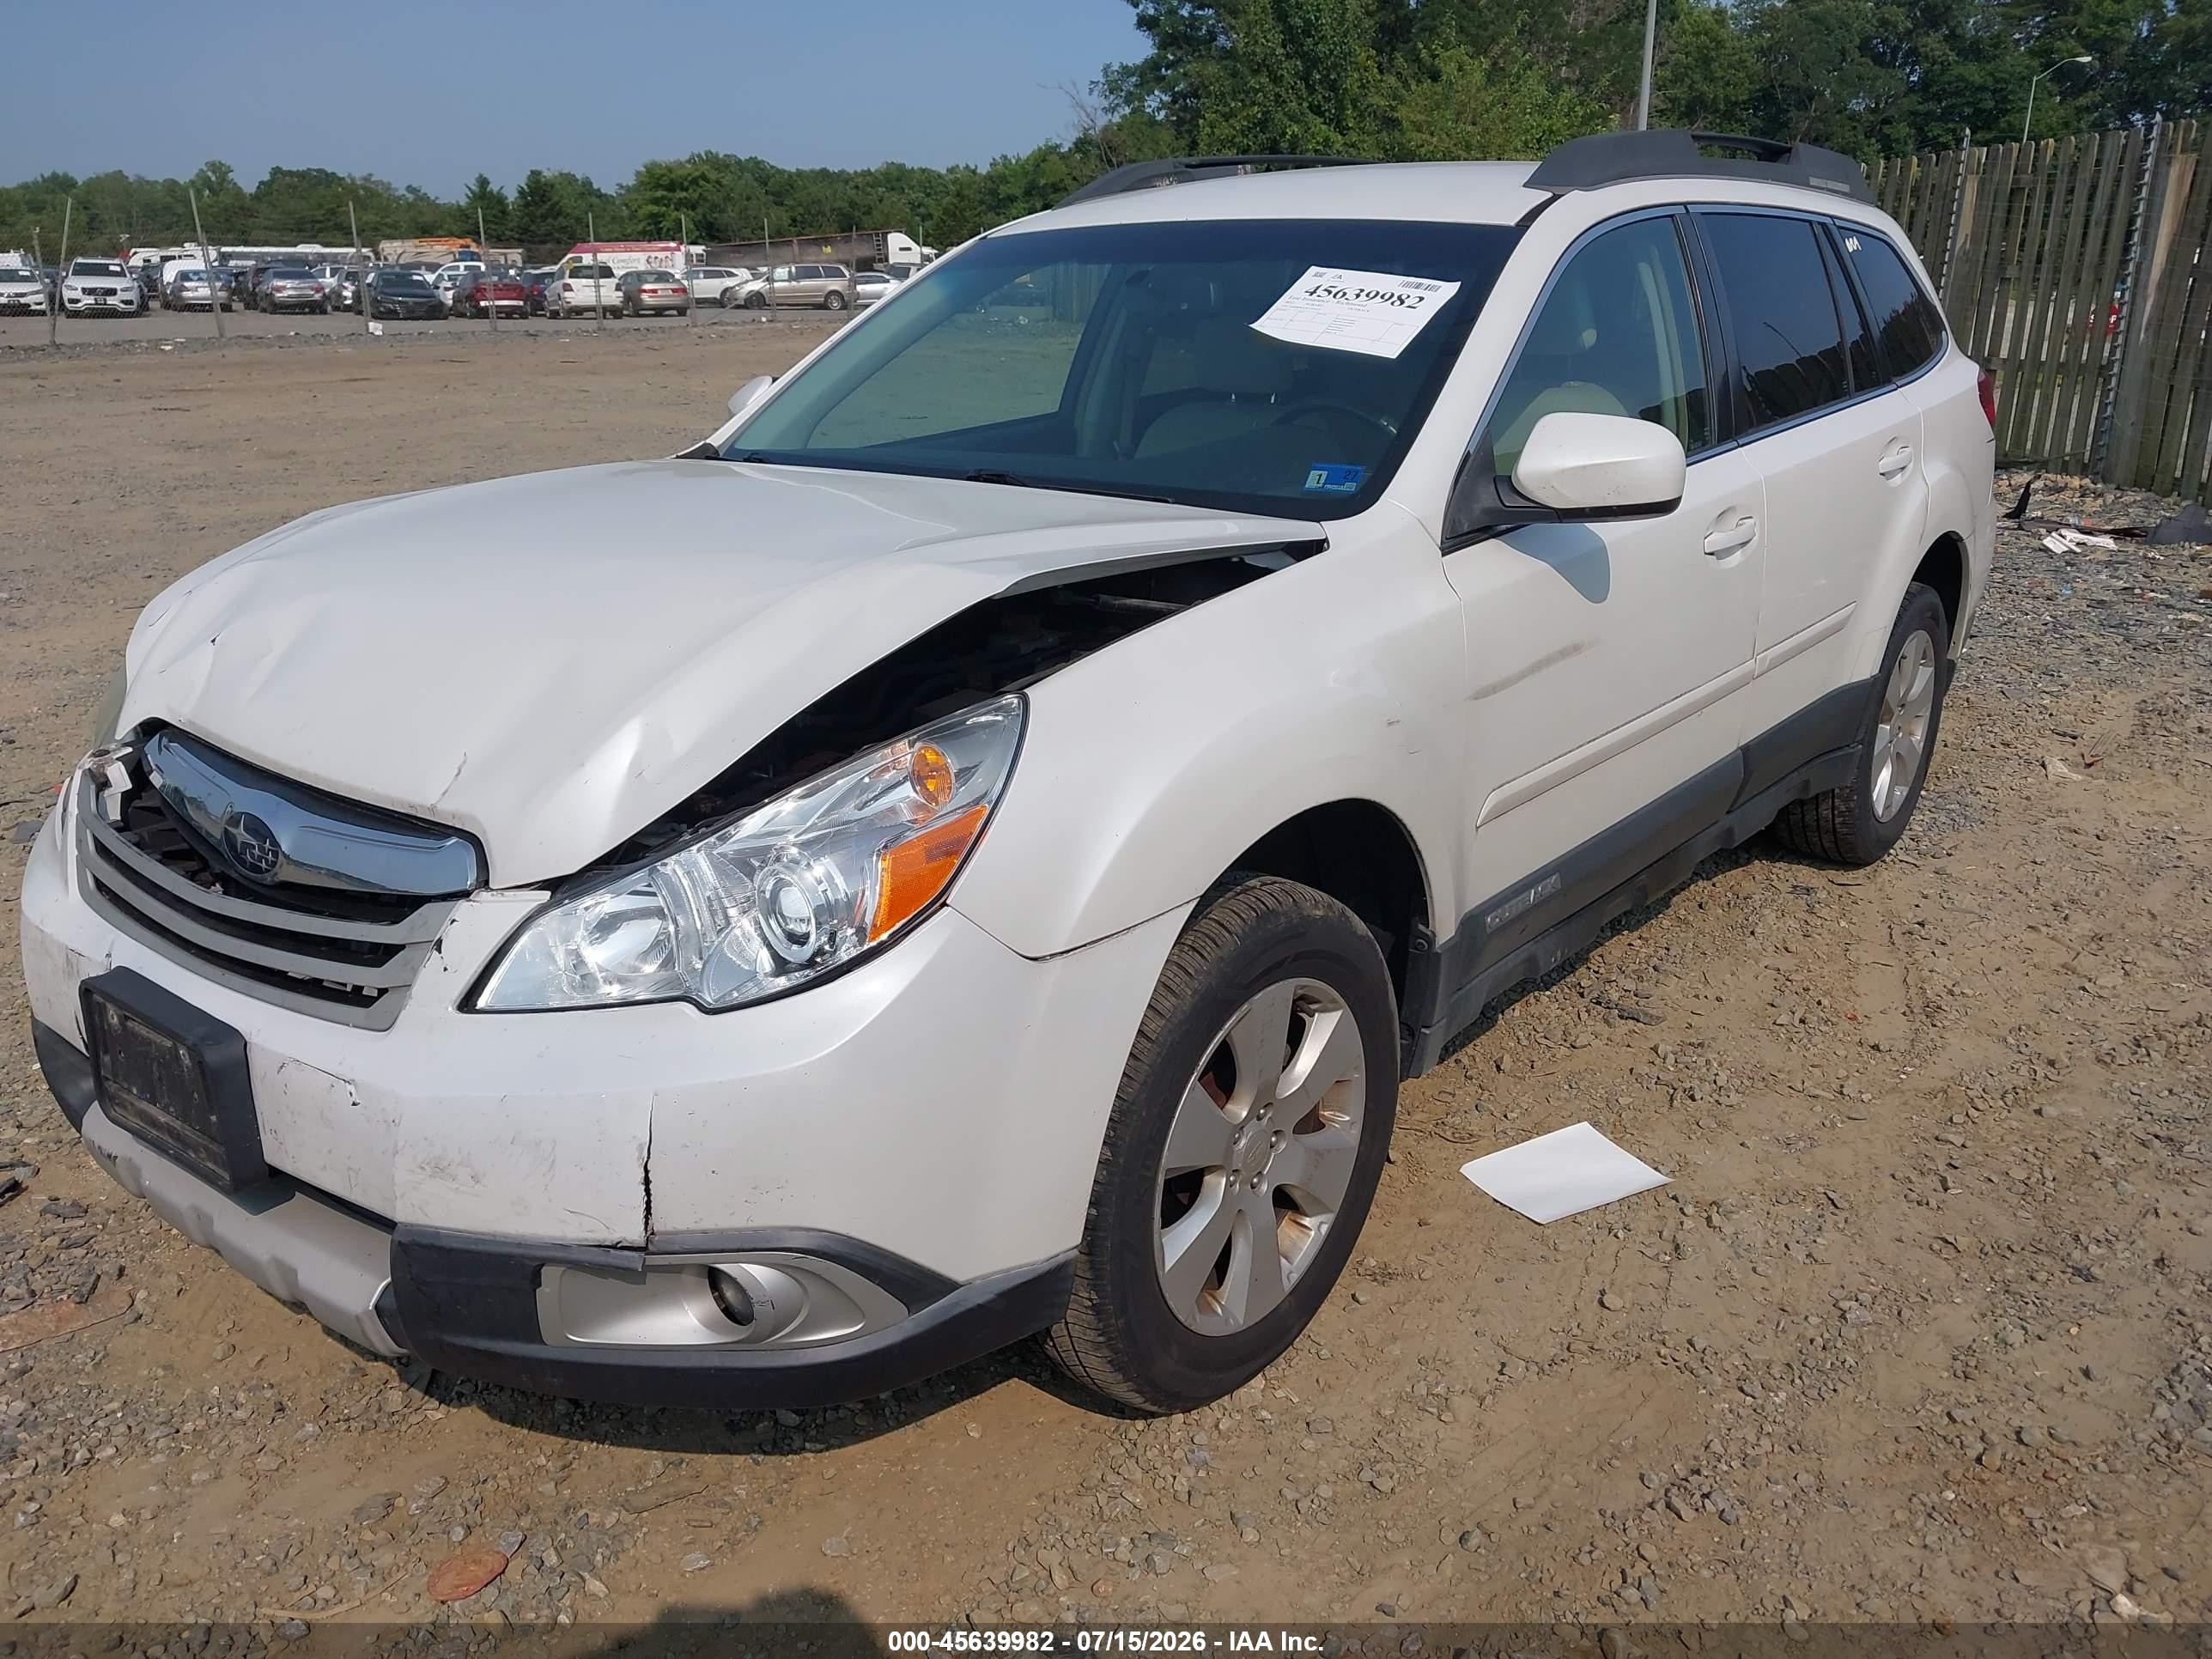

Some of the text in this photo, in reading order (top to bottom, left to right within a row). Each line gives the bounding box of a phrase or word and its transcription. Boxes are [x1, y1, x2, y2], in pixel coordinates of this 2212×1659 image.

[1304, 283, 1425, 310] 45639982
[1315, 470, 1358, 485] 1 27
